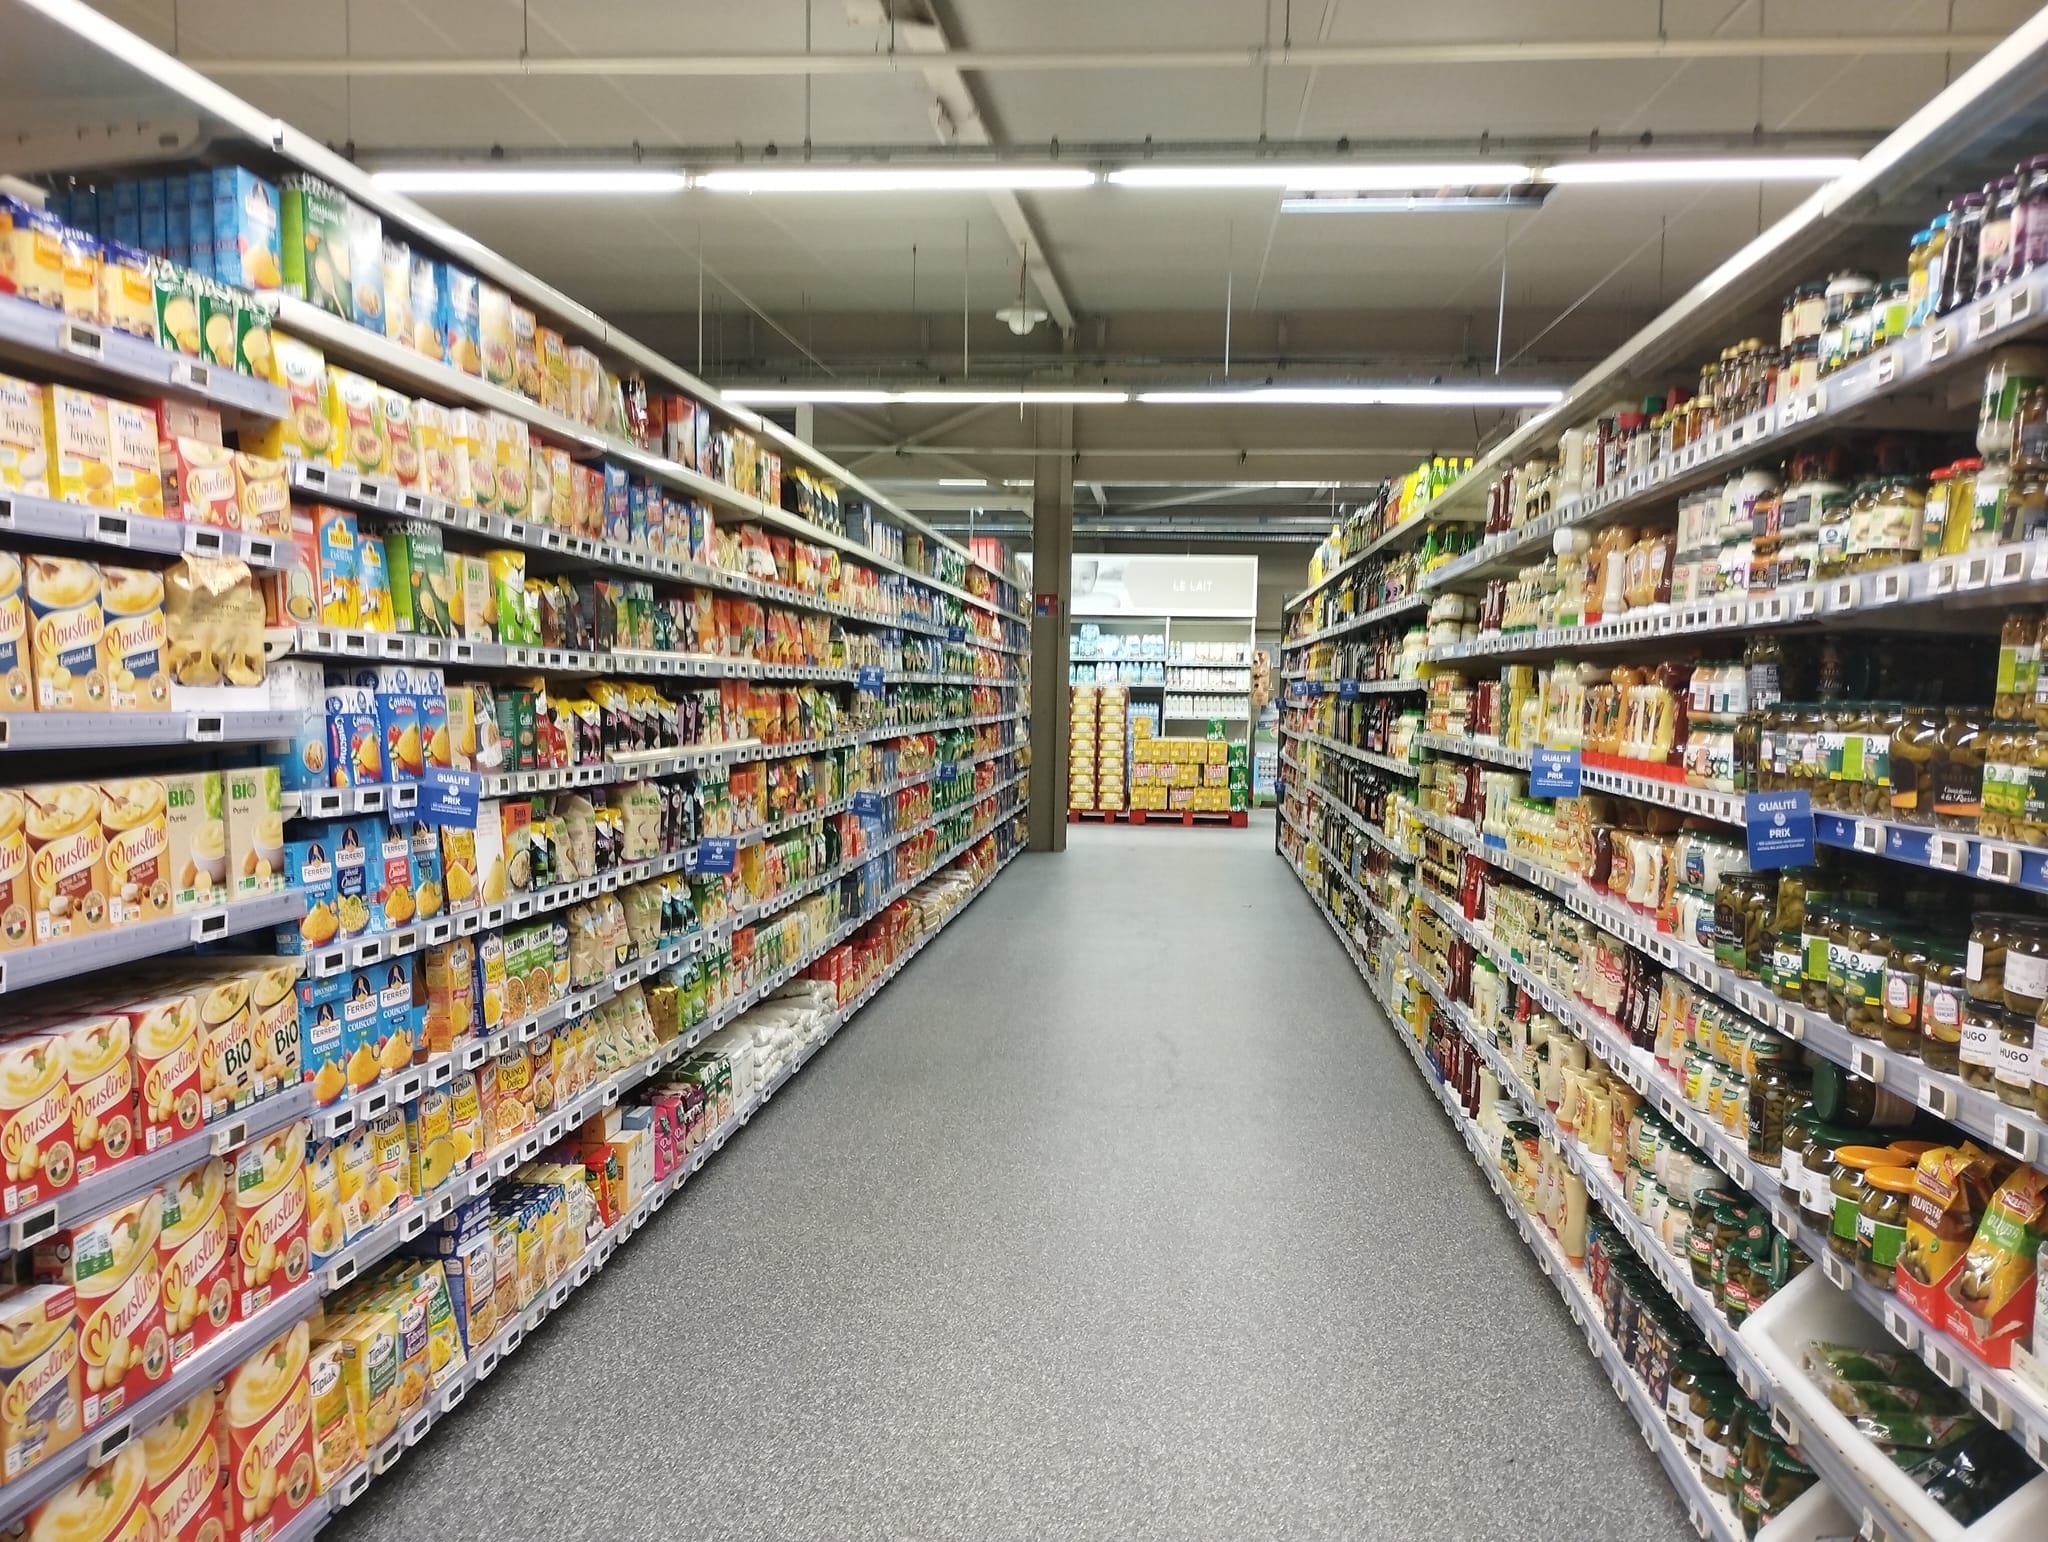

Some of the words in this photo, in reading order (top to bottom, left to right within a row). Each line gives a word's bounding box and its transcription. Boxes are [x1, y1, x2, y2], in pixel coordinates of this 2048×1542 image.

[64, 402, 92, 418] Tipiak
[117, 415, 143, 432] Tipiak
[69, 424, 106, 448] Tapioca
[122, 436, 156, 459] Tapioca
[190, 472, 236, 500] Mousline
[247, 486, 286, 508] Mousline
[1173, 580, 1187, 592] LE
[1190, 580, 1212, 592] LAIT
[38, 608, 101, 652] Mousline
[107, 616, 166, 658] Mousline
[1542, 753, 1571, 764] QUALITÉ
[437, 773, 470, 786] QUALITÉ
[168, 789, 196, 808] BIO
[232, 783, 257, 800] BIO
[443, 795, 461, 806] PRIX
[1758, 798, 1798, 812] QUALITÉ
[1769, 828, 1791, 839] PRIX
[36, 831, 101, 882] Mousline
[110, 825, 167, 870] Mousline
[337, 851, 364, 861] FERRERO
[304, 867, 331, 877] FERRERO
[382, 988, 410, 1002] FERRERO
[346, 1000, 376, 1016] FERRERO
[383, 1004, 410, 1019] COUSCOUS
[254, 1002, 296, 1049] Mousline
[313, 1024, 340, 1039] FERRERO
[347, 1016, 377, 1033] COUSCOUS
[202, 1018, 250, 1068] Mousline
[1963, 1031, 1987, 1042] HUGO
[313, 1040, 340, 1055] COUSCOUS
[2000, 1049, 2029, 1063] HUGO
[500, 1048, 522, 1067] Tipiak
[149, 1047, 197, 1097] Mousline
[501, 1065, 527, 1082] QUINOA
[451, 1073, 472, 1094] Tipiak
[70, 1069, 130, 1118] Mousline
[424, 1099, 443, 1114] Tipiak
[5, 1092, 69, 1155] Mousline
[376, 1115, 400, 1133] Tipiak
[387, 1145, 401, 1161] BIO
[1912, 1195, 1933, 1215] OLIVES
[243, 1182, 305, 1262] Mousline
[163, 1222, 226, 1306] Mousline
[87, 1267, 158, 1359] Mousline
[401, 1309, 421, 1330] Tipiak
[368, 1340, 391, 1361] Tipiak
[8, 1343, 75, 1411] Mousline
[311, 1368, 337, 1396] Tipiak
[243, 1393, 308, 1488] Mousline
